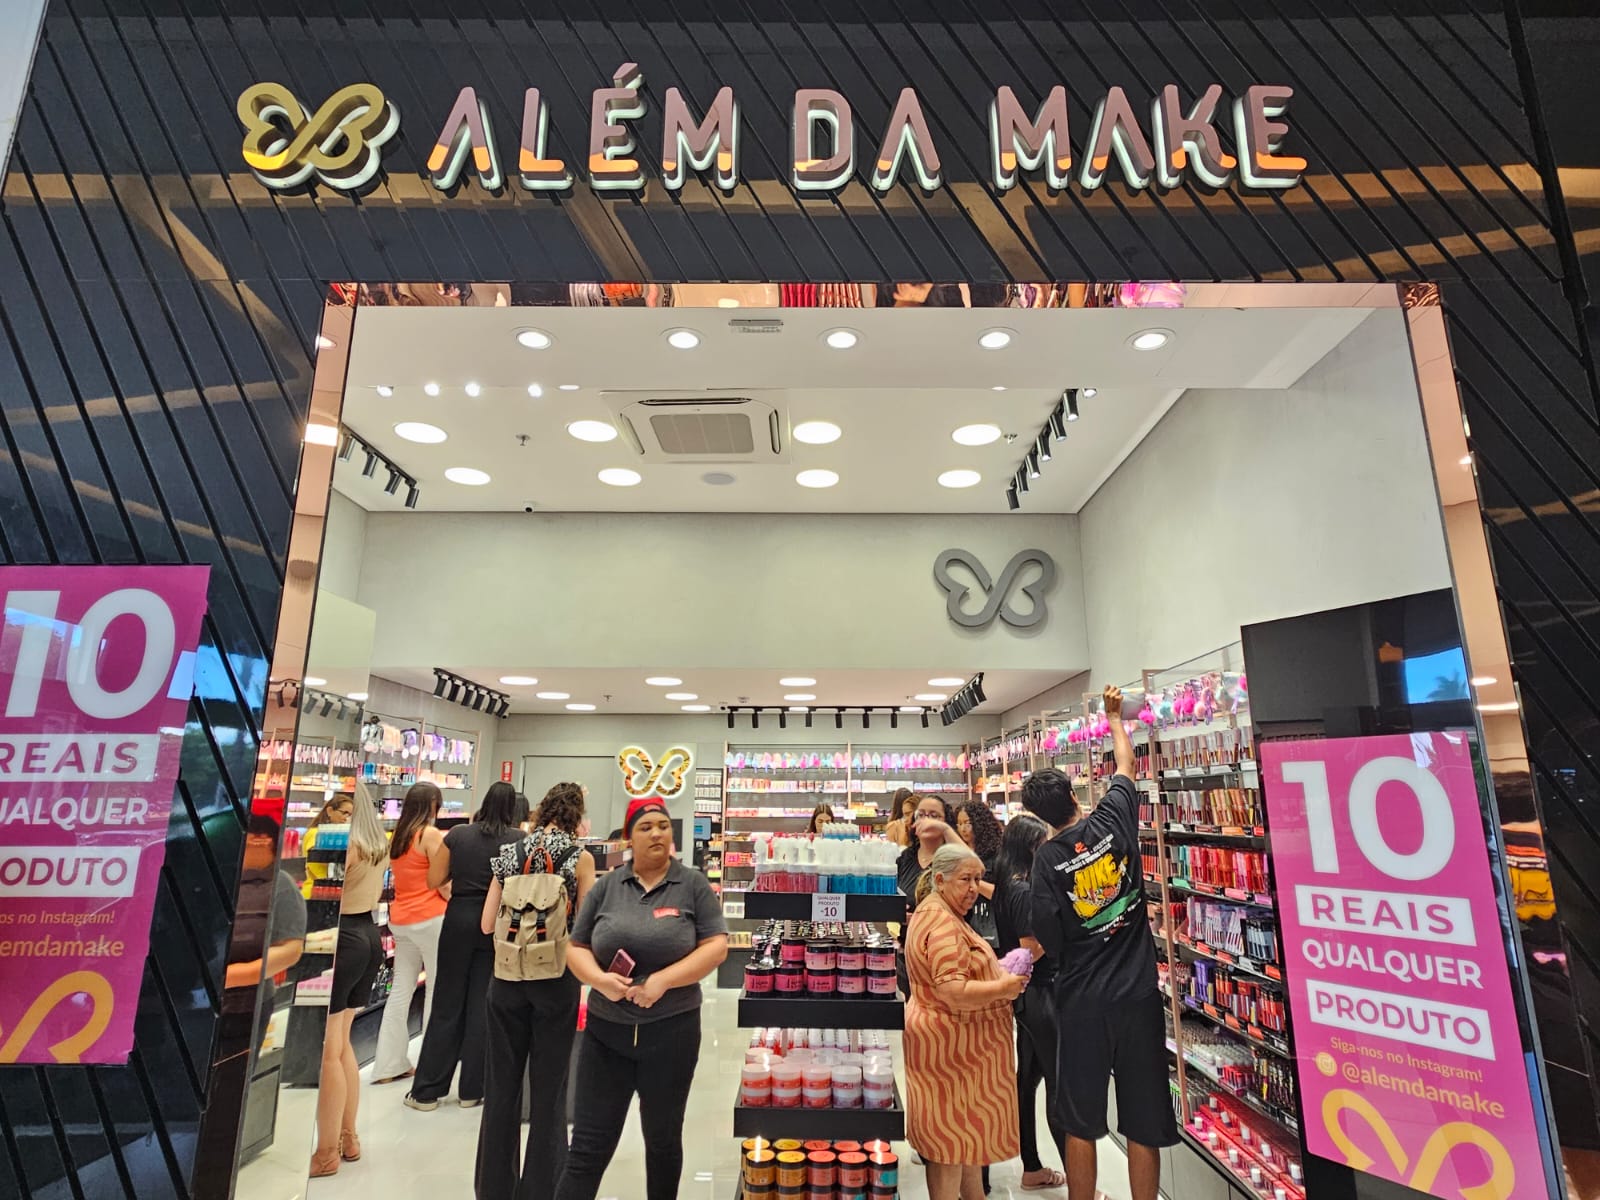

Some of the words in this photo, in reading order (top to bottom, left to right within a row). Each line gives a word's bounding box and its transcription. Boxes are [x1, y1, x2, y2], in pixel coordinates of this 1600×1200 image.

[427, 62, 739, 189] ALÉM
[793, 87, 943, 190] DA
[989, 84, 1308, 189] MAKE
[4, 588, 176, 719] 10
[1281, 756, 1455, 881] 10
[18, 914, 37, 924] no
[41, 910, 116, 927] Instagram!
[1311, 893, 1454, 935] REAIS
[1302, 938, 1485, 990] QUALQUER
[1315, 990, 1482, 1045] PRODUTO
[1330, 1036, 1384, 1060] Siga-nos
[1386, 1052, 1404, 1065] no
[1407, 1054, 1484, 1083] Instagram!
[1342, 1062, 1506, 1119] @alemdamake
